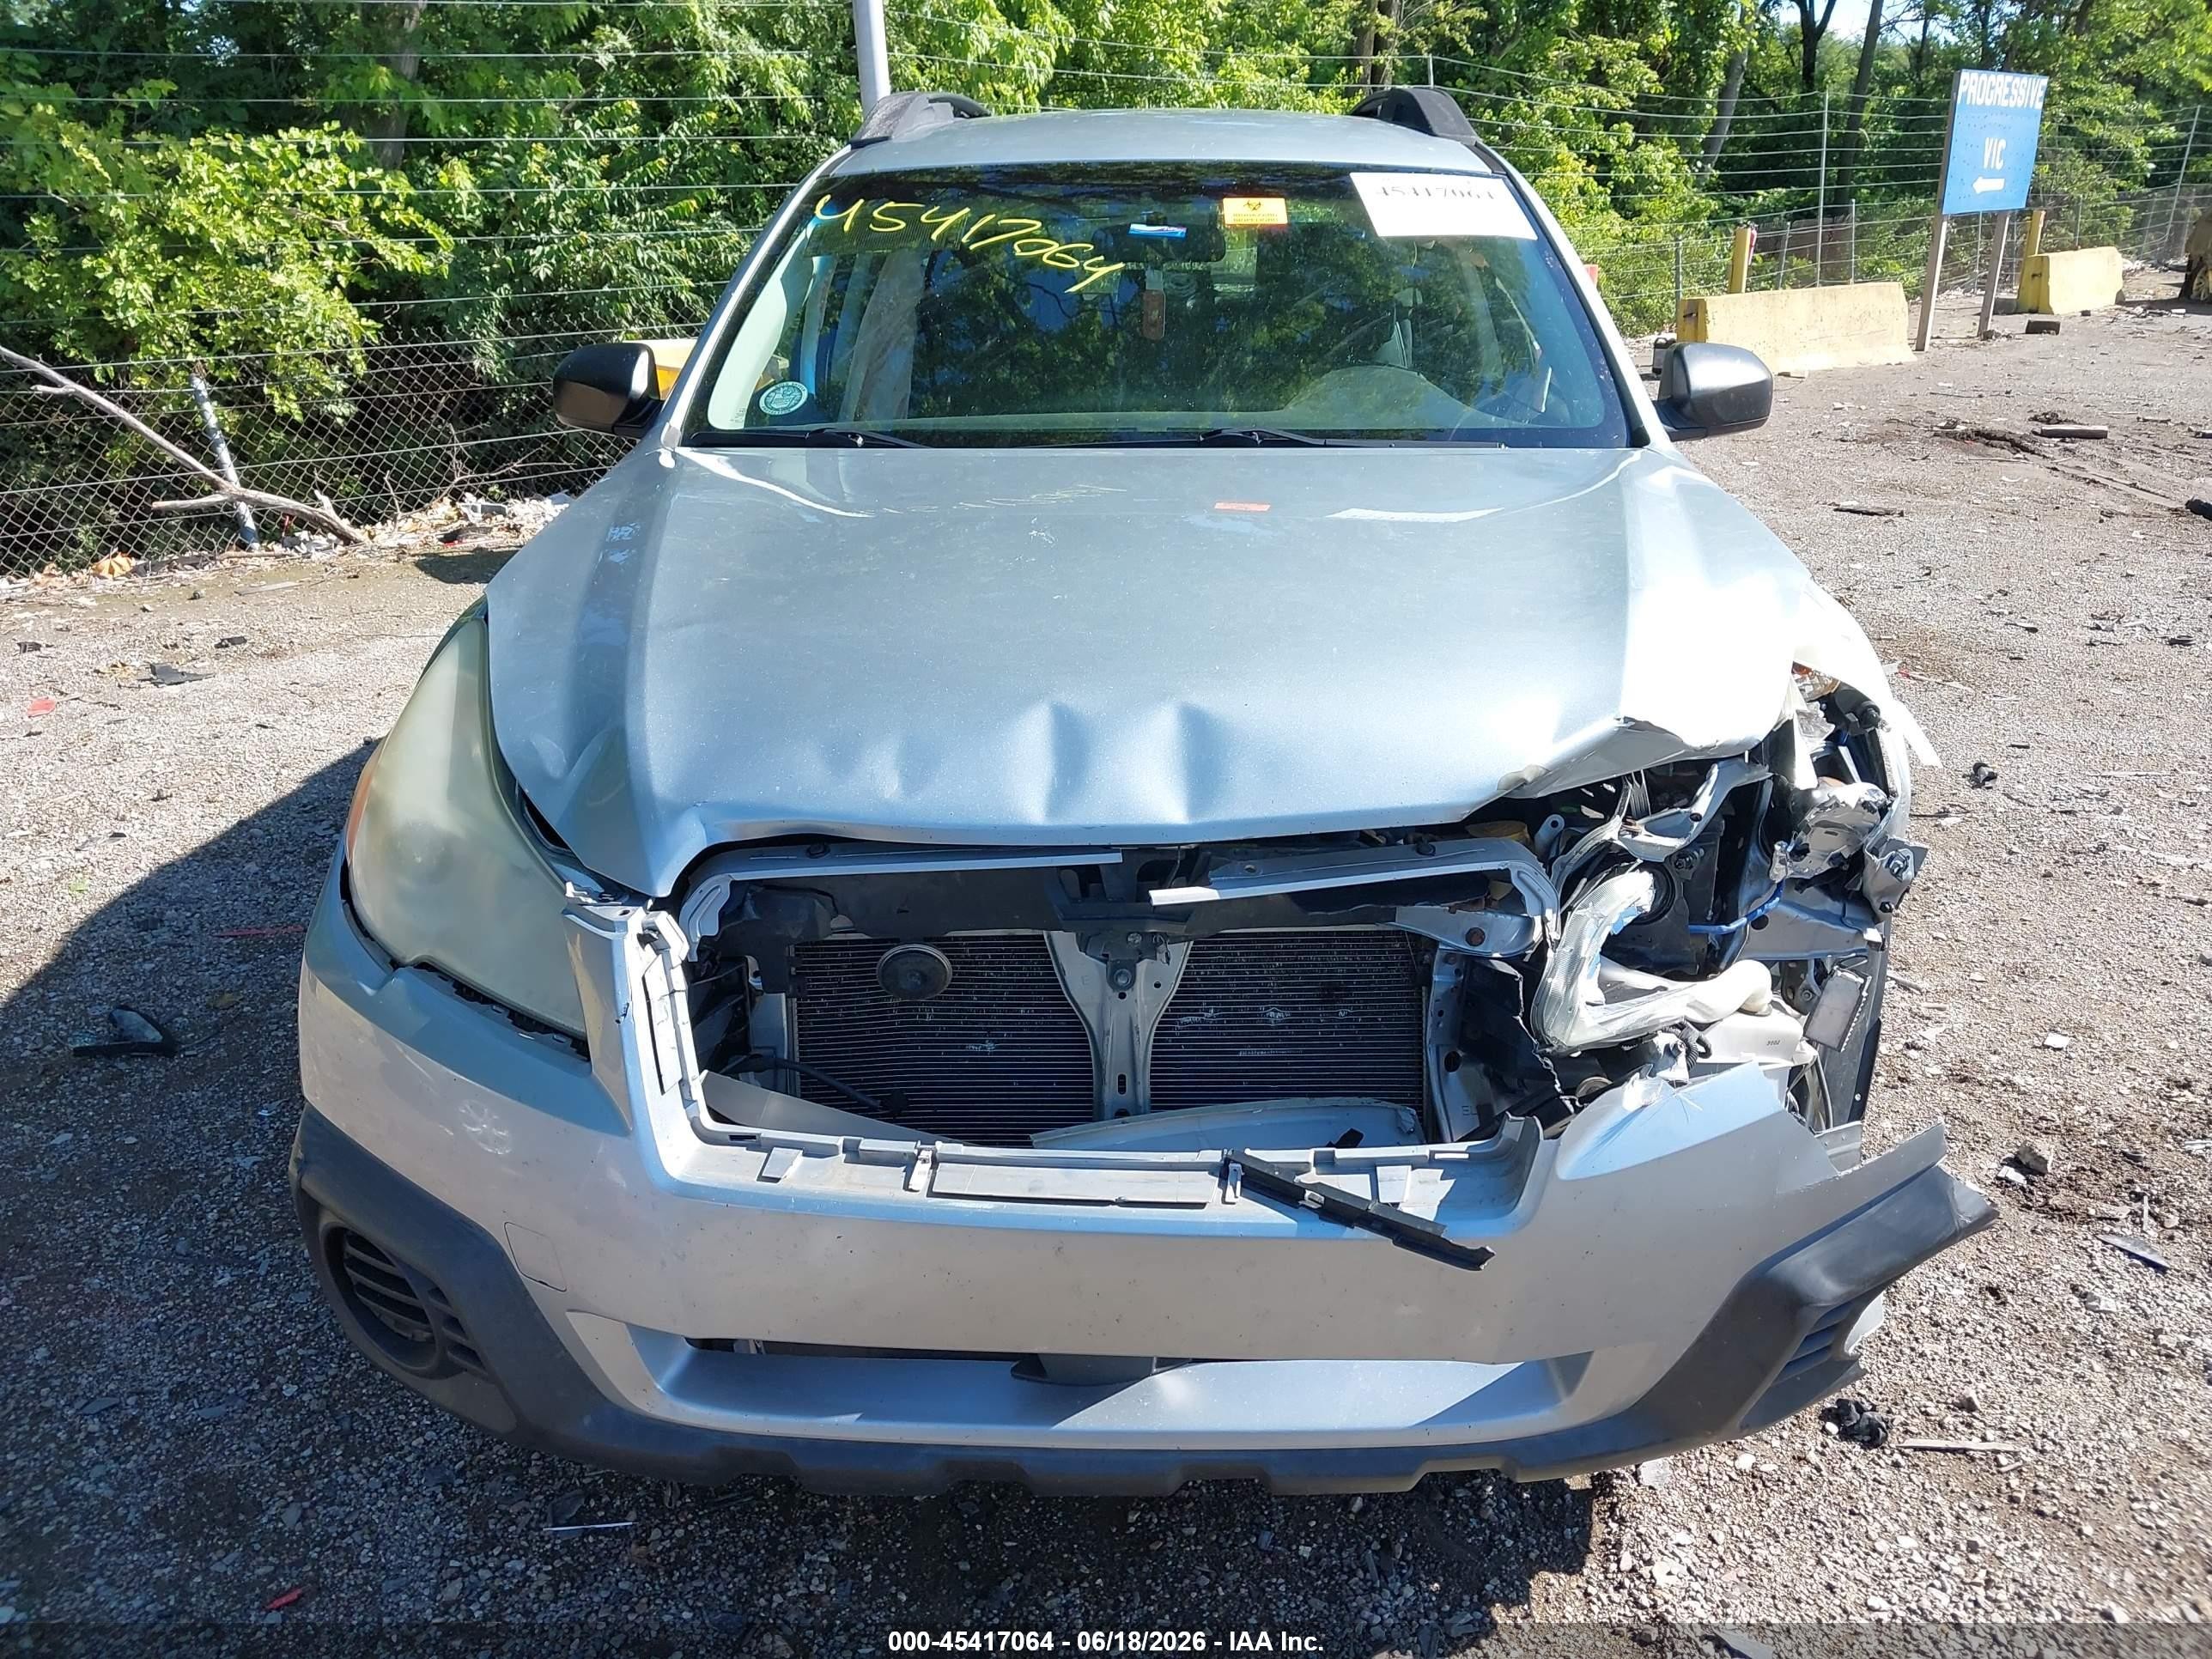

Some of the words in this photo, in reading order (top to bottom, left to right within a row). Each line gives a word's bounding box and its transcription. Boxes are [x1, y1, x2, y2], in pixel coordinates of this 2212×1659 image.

[1957, 71, 2049, 110] PROGRESSIVE
[1983, 137, 2007, 170] VIC
[814, 194, 1125, 294] 45417064
